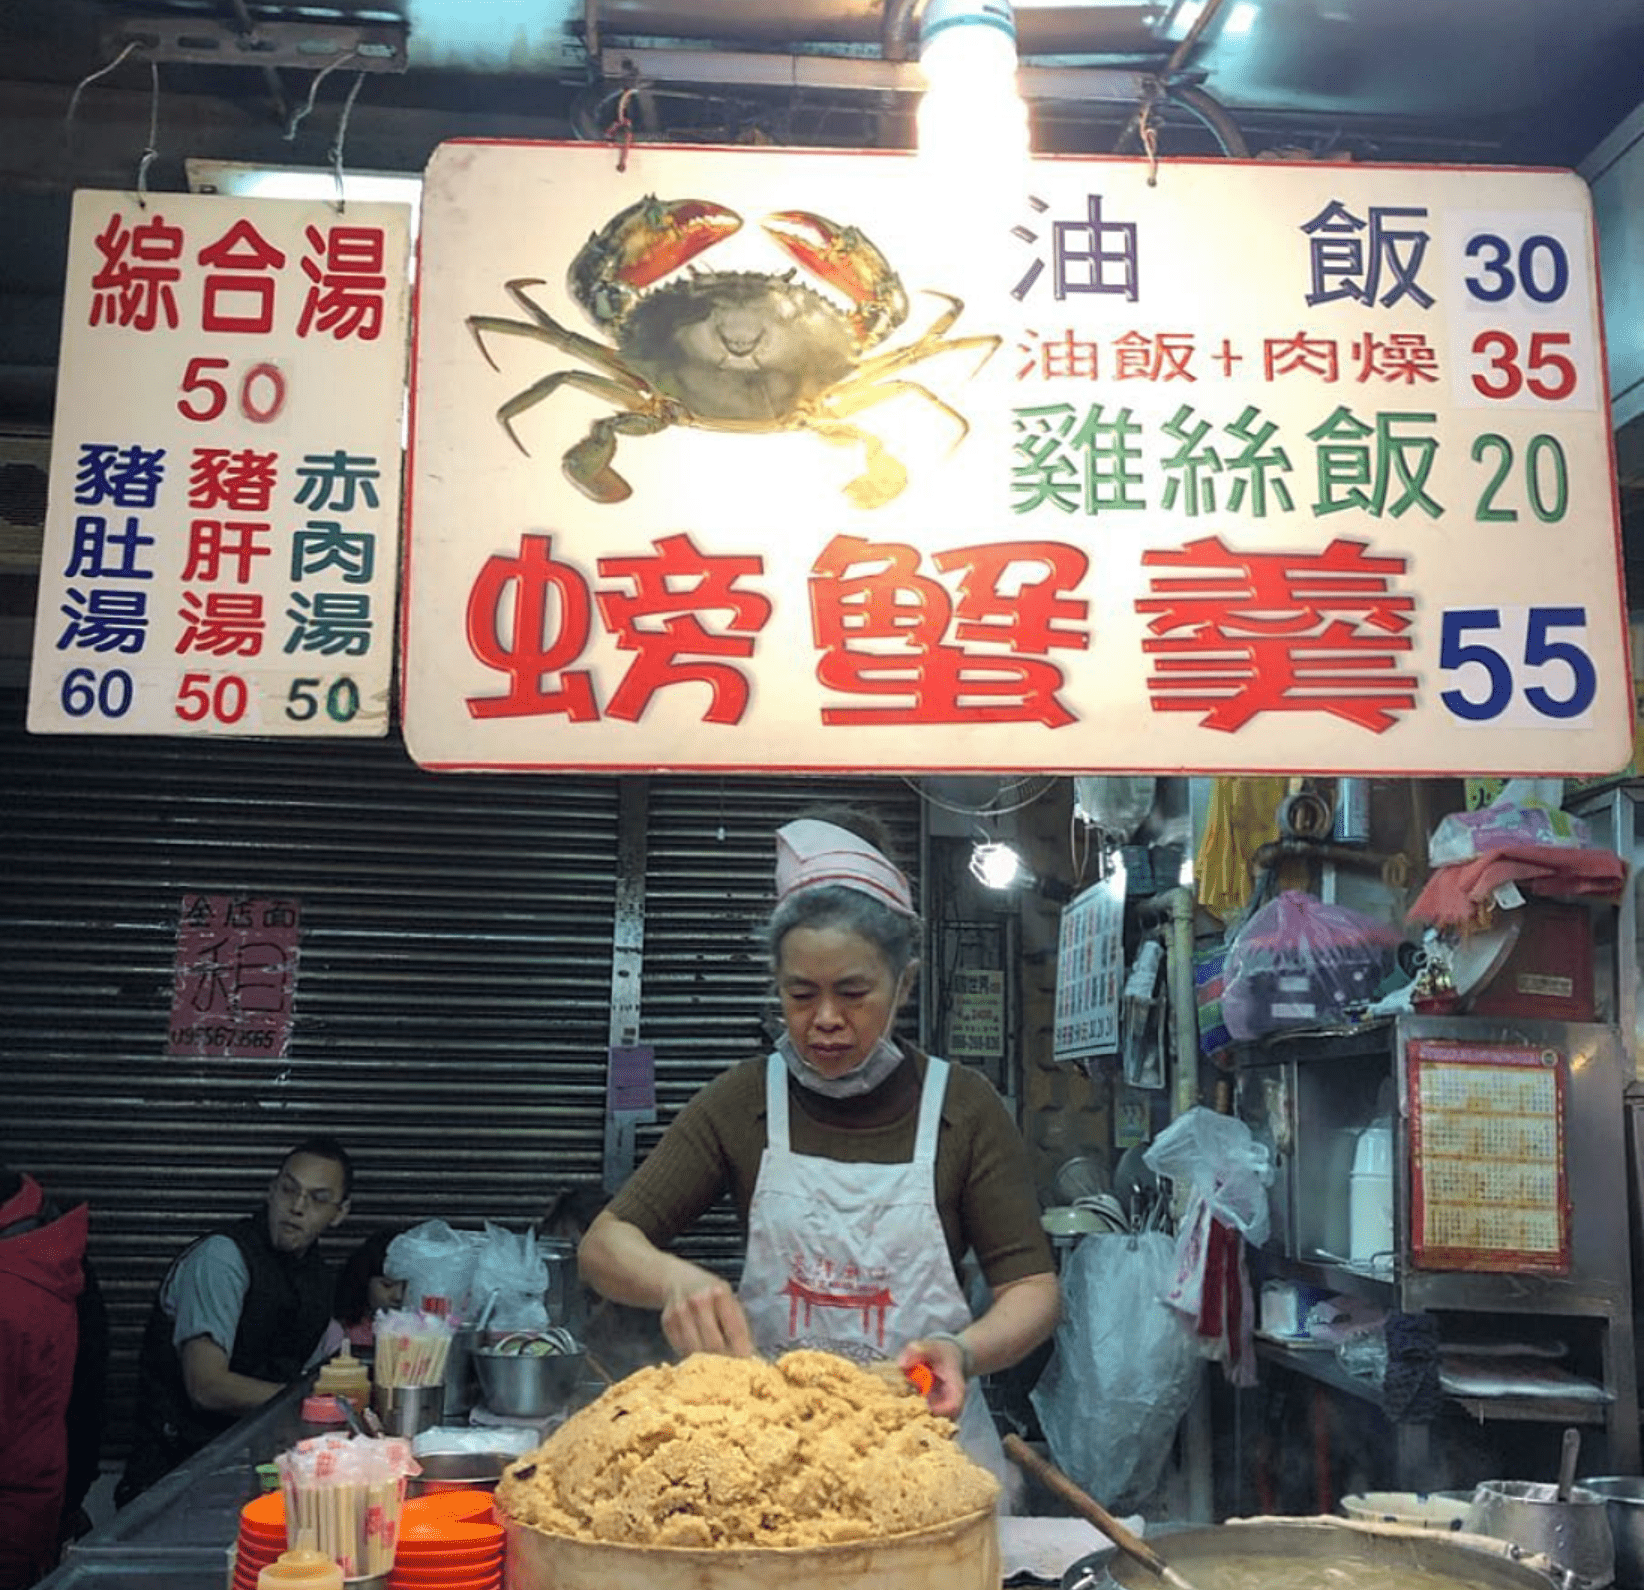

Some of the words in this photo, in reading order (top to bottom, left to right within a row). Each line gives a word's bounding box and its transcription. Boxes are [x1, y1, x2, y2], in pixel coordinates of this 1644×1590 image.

[87, 213, 388, 341] 綜合湯
[1011, 193, 1437, 309] 油飯
[1464, 233, 1570, 304] 30
[177, 357, 286, 424] 50
[1470, 329, 1578, 402] 35
[1011, 402, 1446, 519] 雞絲飯
[1471, 432, 1569, 524] 20
[56, 443, 167, 655] 豬肚湯
[174, 447, 279, 657] 豬肝湯
[284, 450, 381, 656] 赤肉湯
[465, 532, 1419, 734] 螃蟹羹
[1440, 607, 1598, 721] 55
[61, 668, 134, 718] 60
[174, 674, 248, 725] 50
[285, 676, 361, 724] 50
[189, 937, 289, 1013] 租
